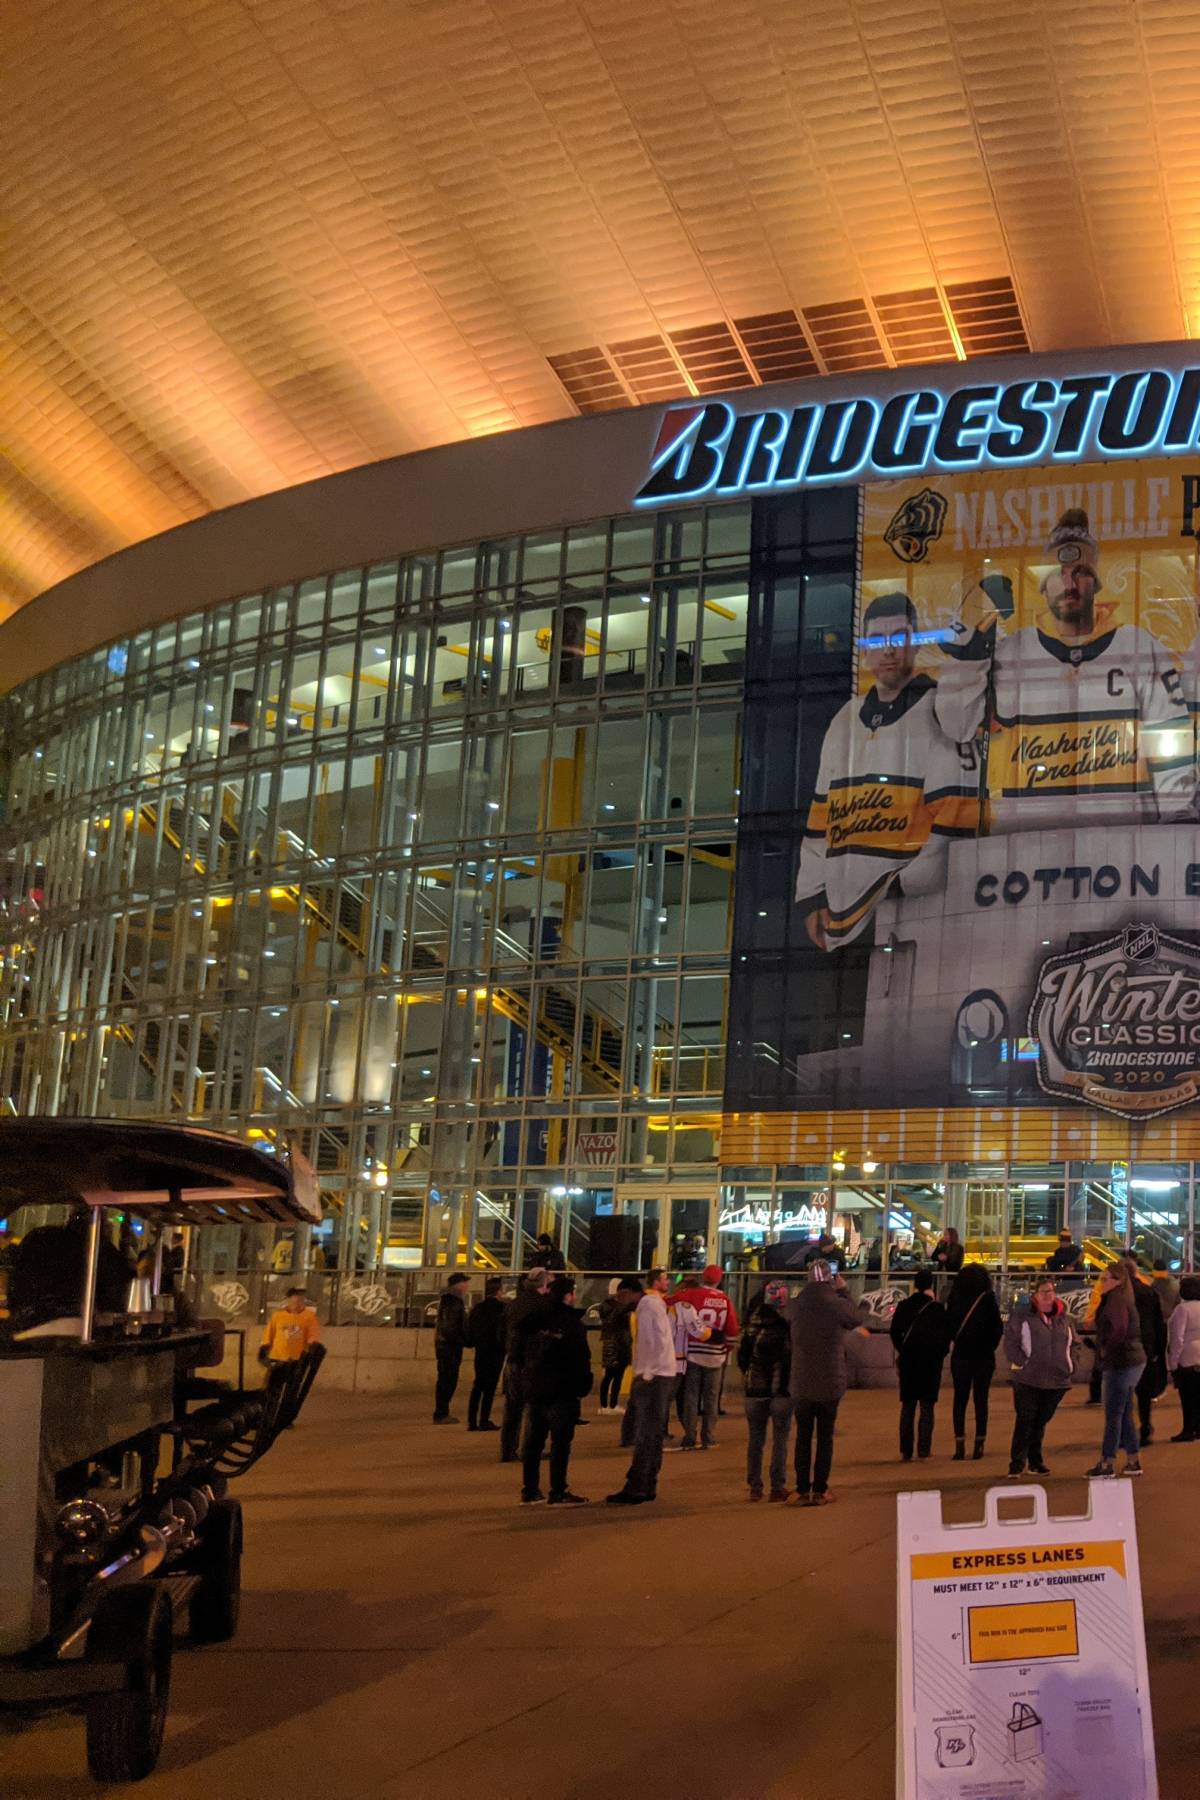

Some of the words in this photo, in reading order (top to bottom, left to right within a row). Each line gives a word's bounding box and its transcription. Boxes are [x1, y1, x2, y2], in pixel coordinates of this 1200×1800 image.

[954, 478, 1170, 550] NASHVILLE
[1107, 668, 1124, 696] C
[1011, 725, 1120, 763] Nashville
[1027, 750, 1138, 788] Predators
[974, 864, 1159, 907] COTTON
[1130, 935, 1153, 955] NHL
[1086, 1051, 1195, 1066] BRIDGESTONE
[1114, 1071, 1165, 1084] 2020
[953, 1553, 1026, 1570] EXPRESS
[1032, 1548, 1085, 1564] LANES
[933, 1583, 957, 1594] MUST
[959, 1581, 983, 1593] MEET
[1047, 1573, 1106, 1586] REQUIREMENT
